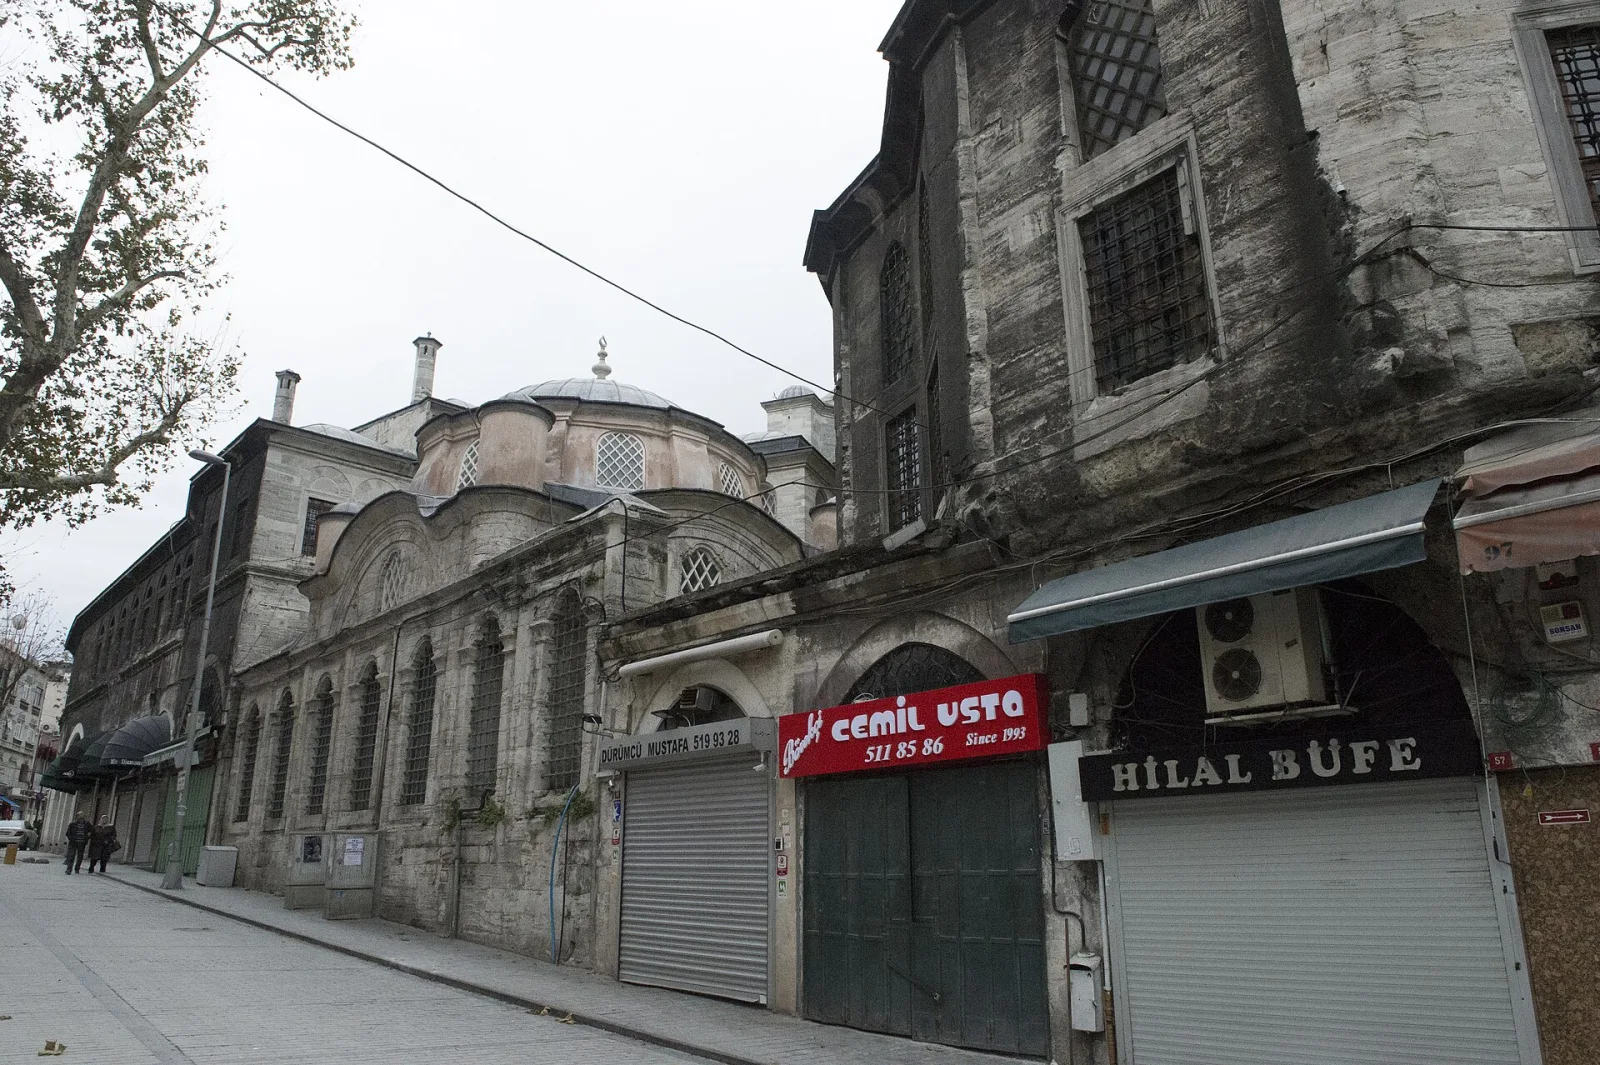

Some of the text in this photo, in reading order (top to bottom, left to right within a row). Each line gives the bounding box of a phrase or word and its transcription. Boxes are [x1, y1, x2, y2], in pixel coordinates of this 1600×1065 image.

[1549, 623, 1582, 635] SORSAN
[601, 729, 740, 763] DÜRÜMCÜ MUSTAFA 519 93 28
[965, 726, 1027, 746] Since 1993
[864, 736, 944, 763] 511 85 86
[1494, 756, 1506, 765] 57
[1111, 737, 1422, 792] HİLAL BÜFE
